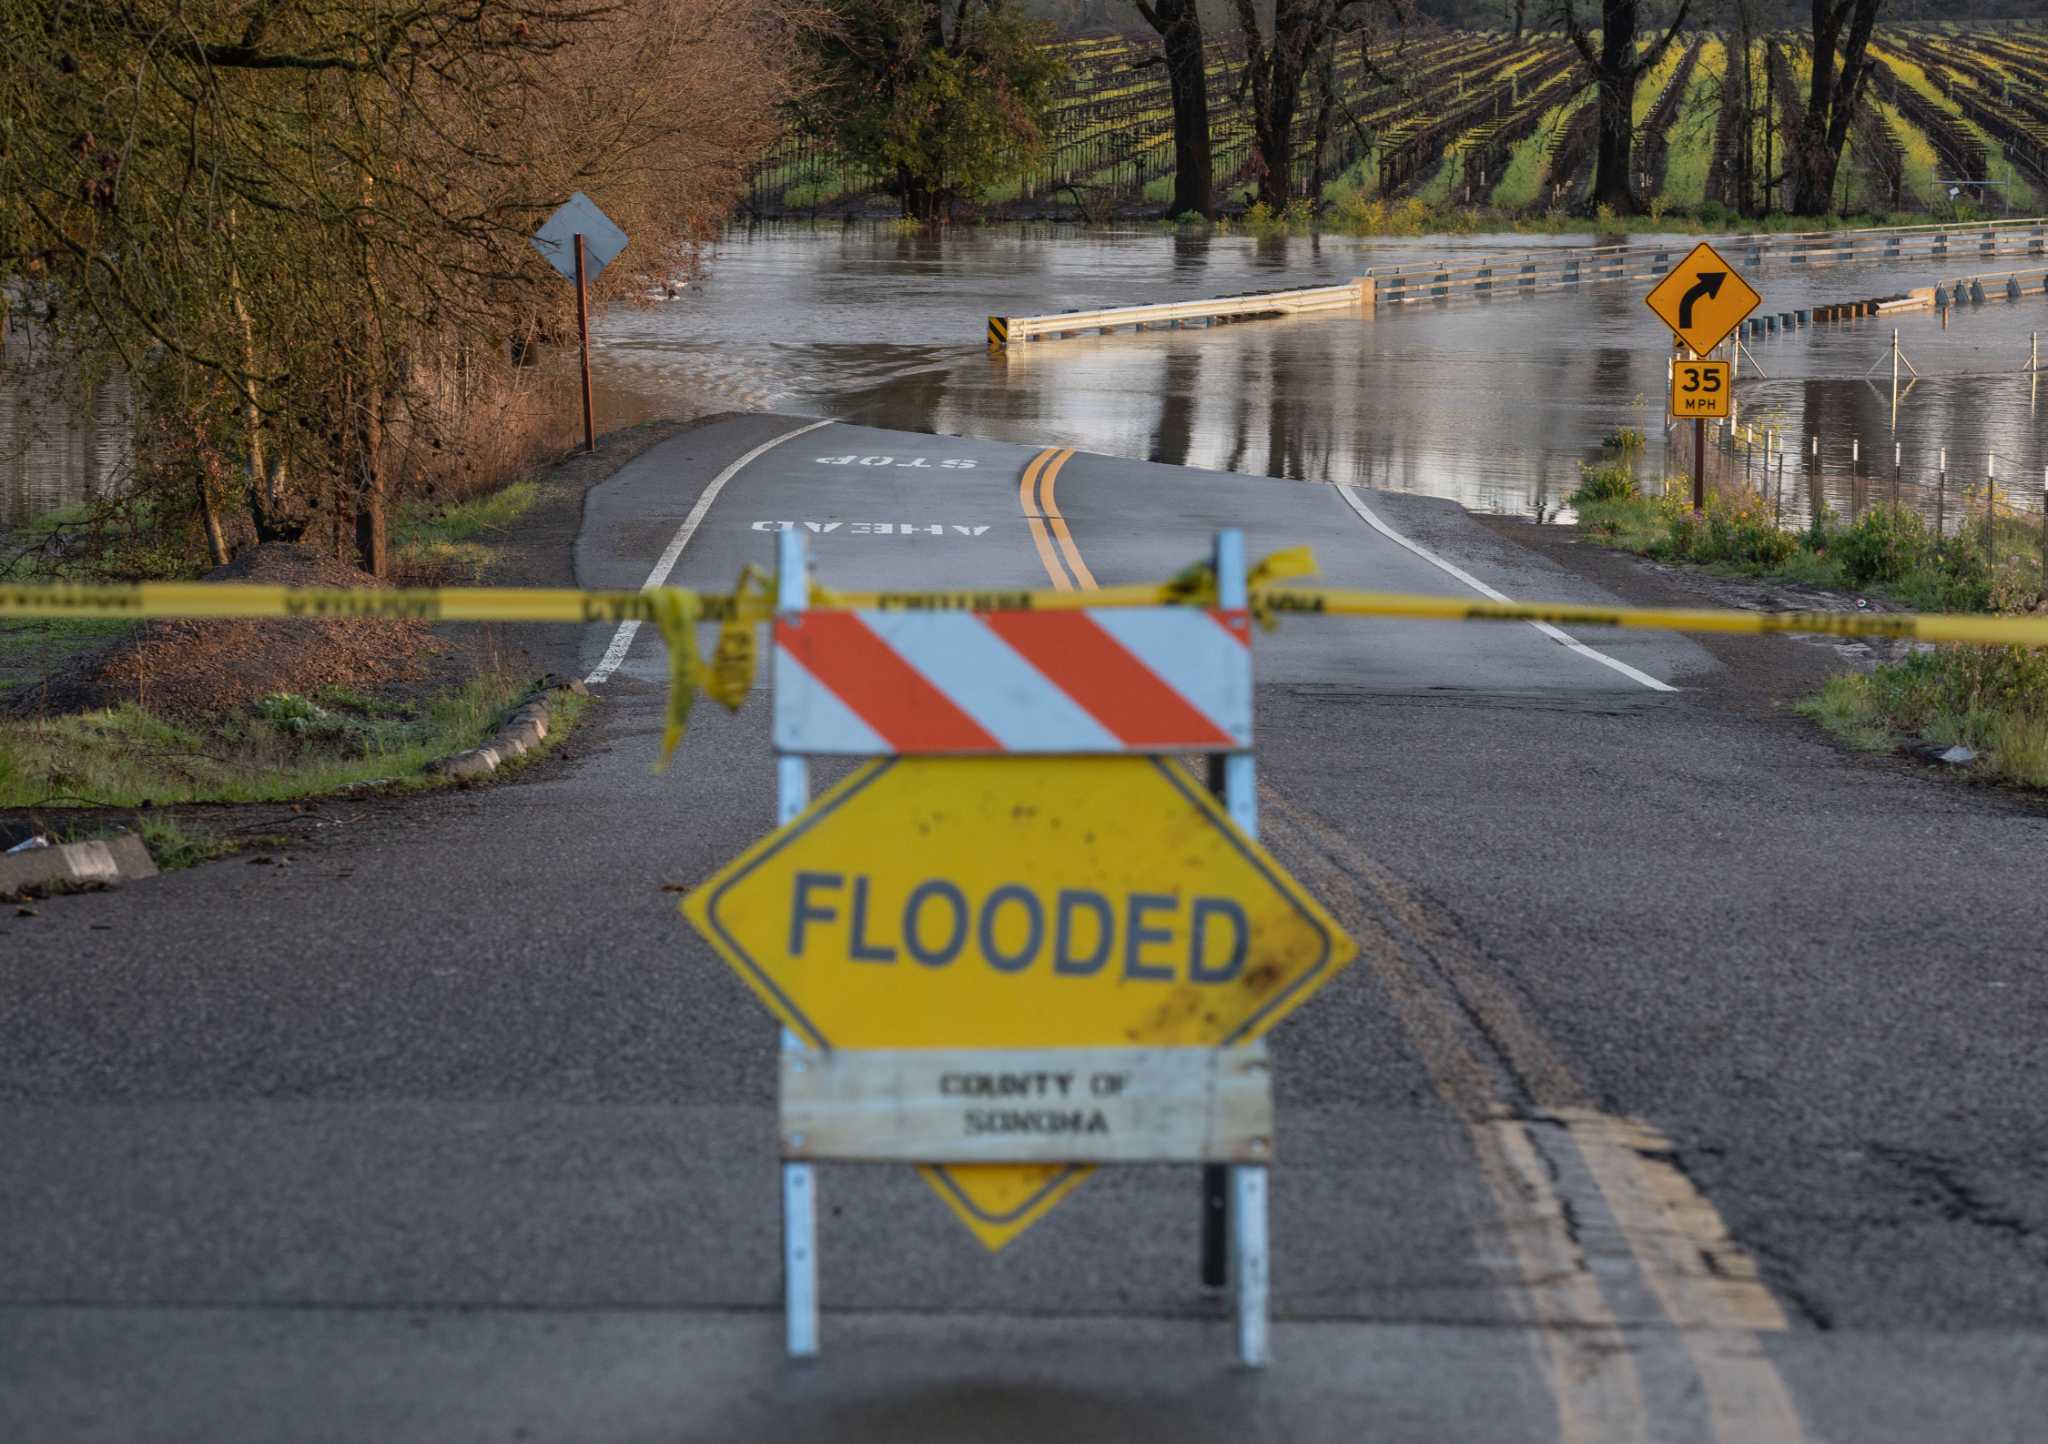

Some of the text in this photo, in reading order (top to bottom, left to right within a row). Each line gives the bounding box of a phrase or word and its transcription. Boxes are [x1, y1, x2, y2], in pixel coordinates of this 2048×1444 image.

[1682, 368, 1721, 393] 35
[1685, 398, 1716, 410] MPH
[815, 455, 978, 469] STOP
[751, 520, 990, 536] AHEAD
[787, 870, 1251, 986] FLOODED
[940, 1072, 1130, 1096] COUNTY OF
[963, 1108, 1109, 1136] SONOMA
